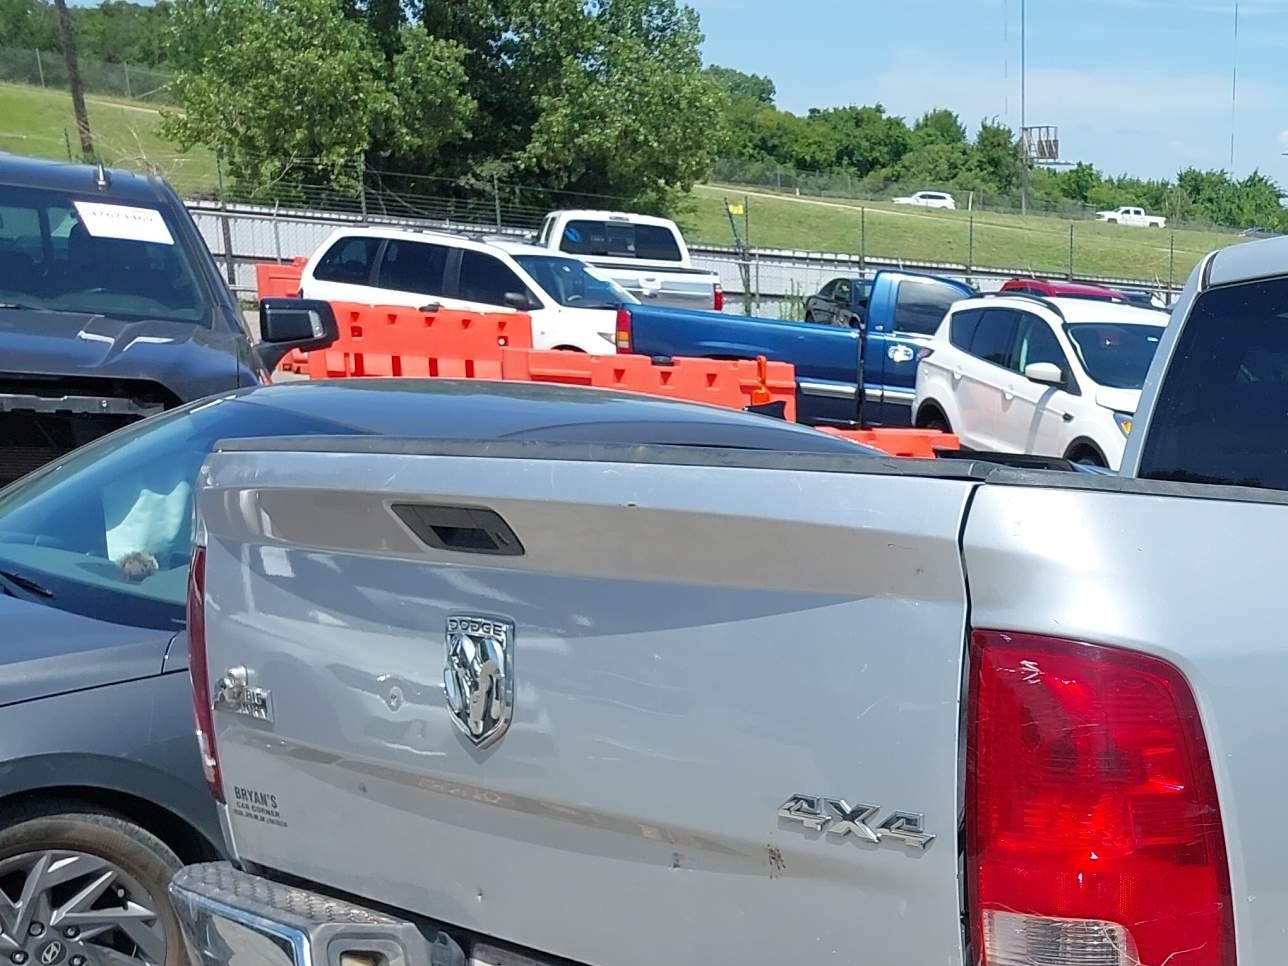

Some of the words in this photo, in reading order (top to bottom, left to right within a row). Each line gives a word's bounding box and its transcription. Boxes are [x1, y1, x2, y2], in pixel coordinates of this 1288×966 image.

[448, 618, 504, 638] DODGE
[234, 785, 279, 809] BRYAN'S
[235, 800, 250, 811] CAR
[251, 804, 281, 818] CORNER
